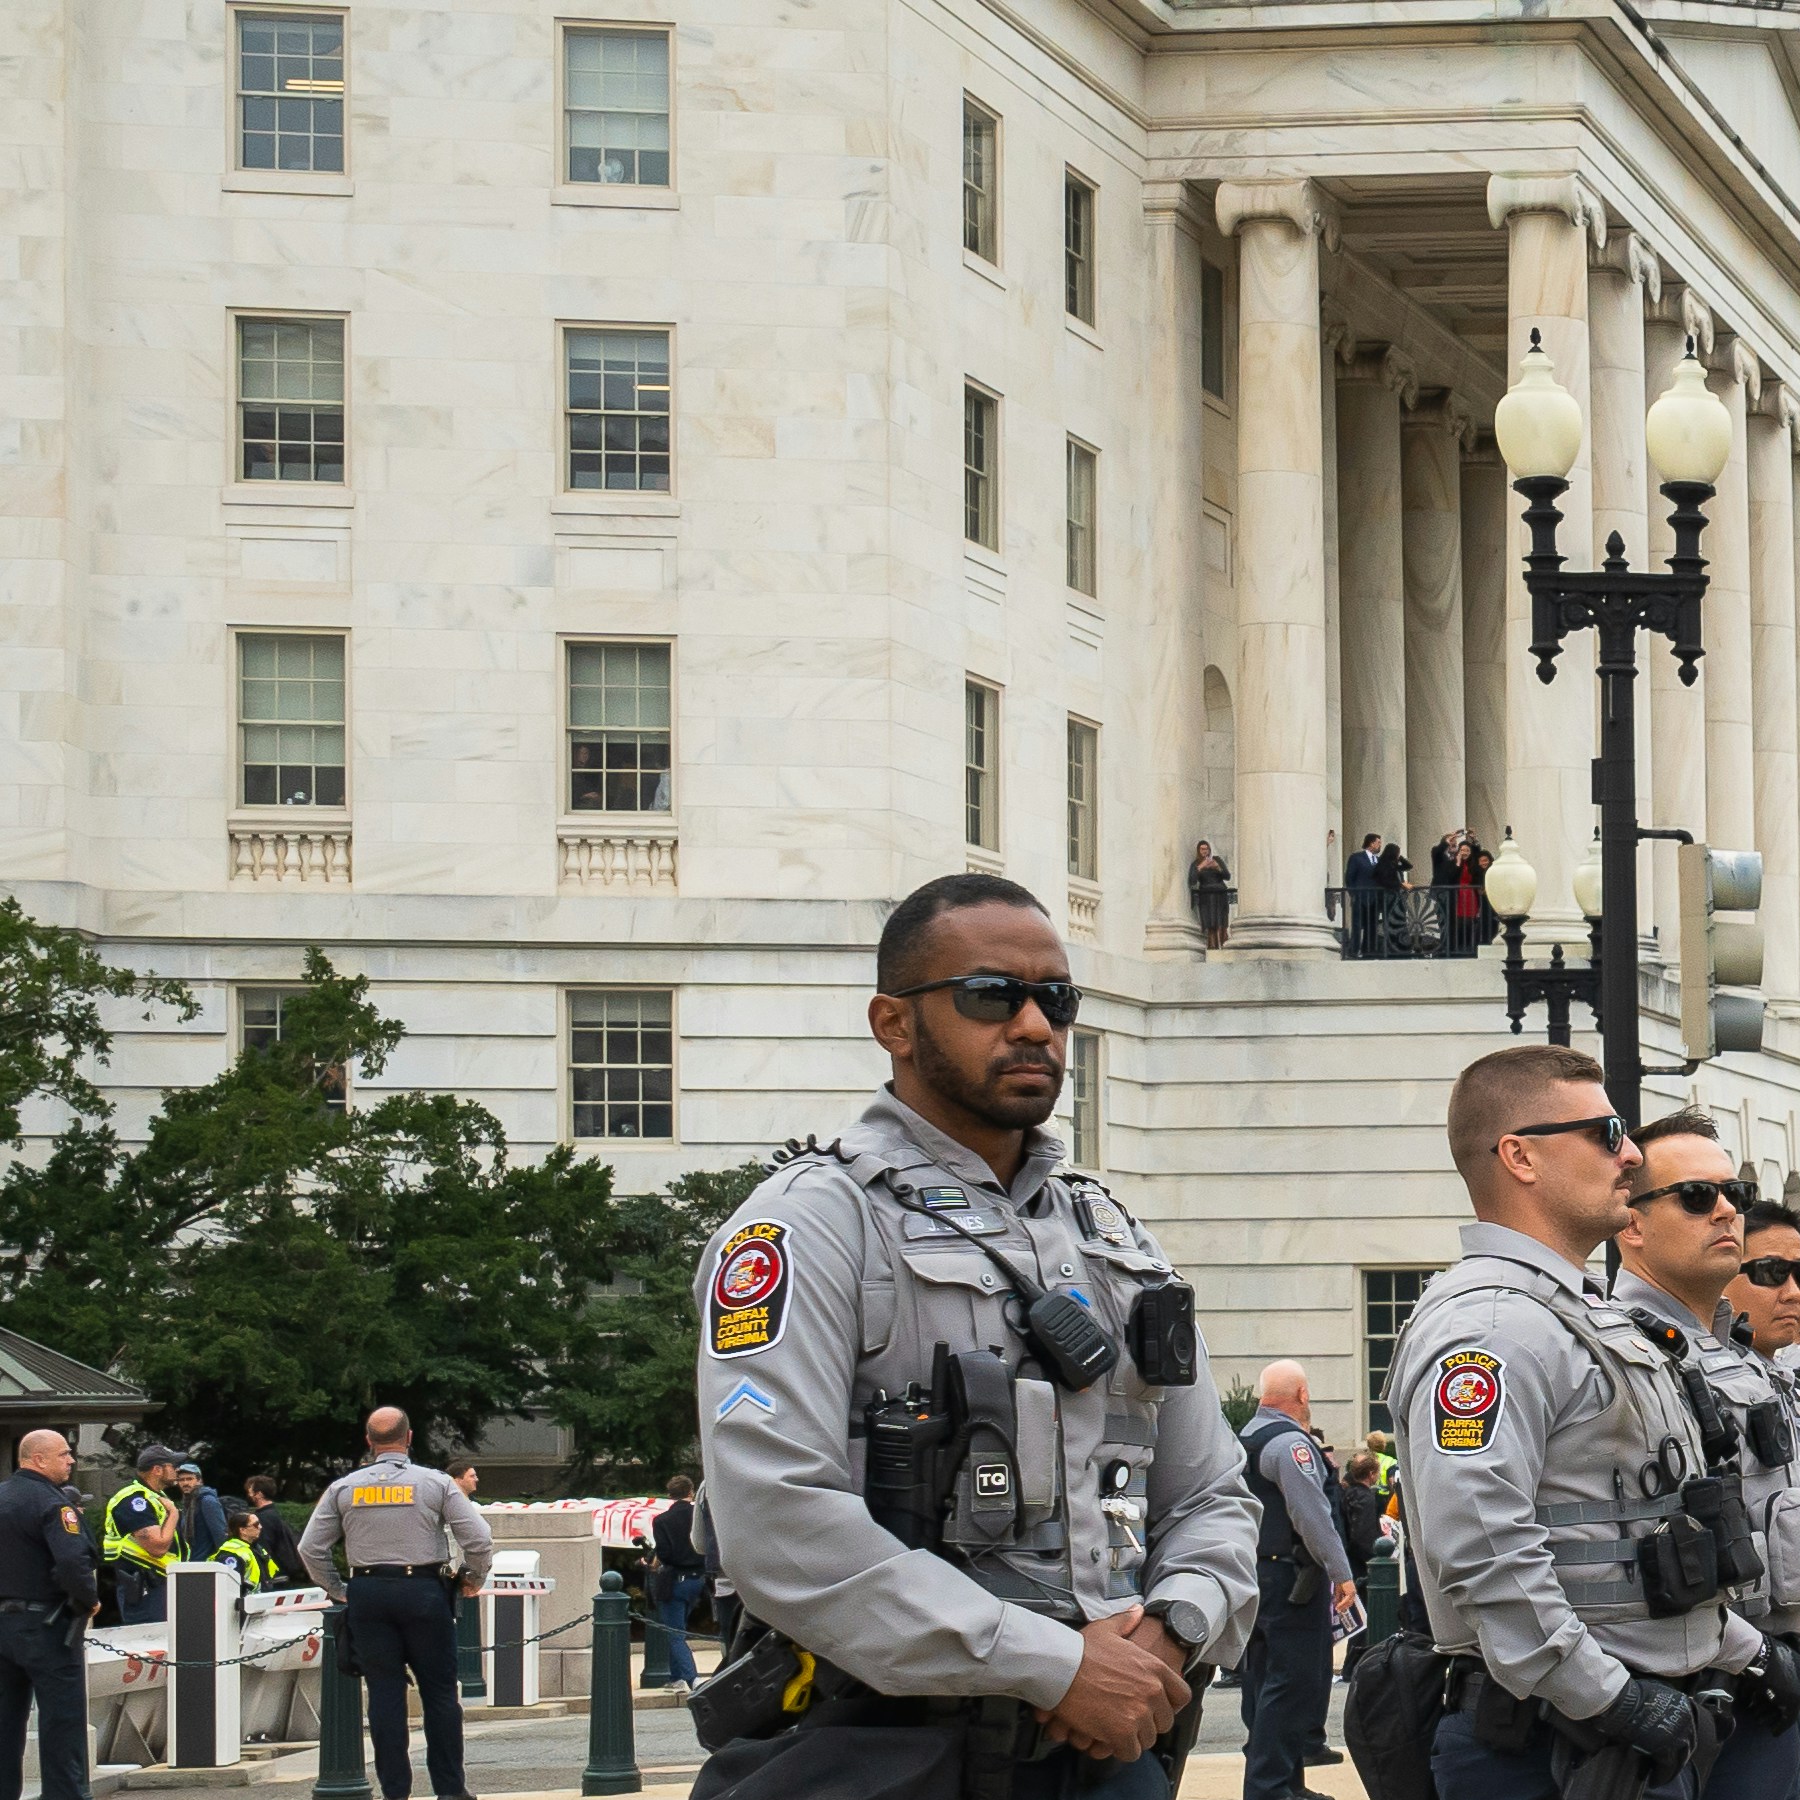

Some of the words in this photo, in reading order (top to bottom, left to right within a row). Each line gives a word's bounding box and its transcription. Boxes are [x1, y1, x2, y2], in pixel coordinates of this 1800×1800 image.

[724, 1224, 782, 1255] POLICE
[719, 1306, 770, 1328] FAIRFAX
[717, 1318, 770, 1339] COUNTY
[716, 1330, 770, 1351] VIRGINIA
[1445, 1353, 1498, 1371] POLICE
[1441, 1428, 1484, 1438] COUNTY
[1443, 1419, 1485, 1429] FAIRFAX
[1441, 1437, 1483, 1447] VIRGINIA
[978, 1472, 1006, 1488] TQ
[353, 1484, 415, 1505] POLICE
